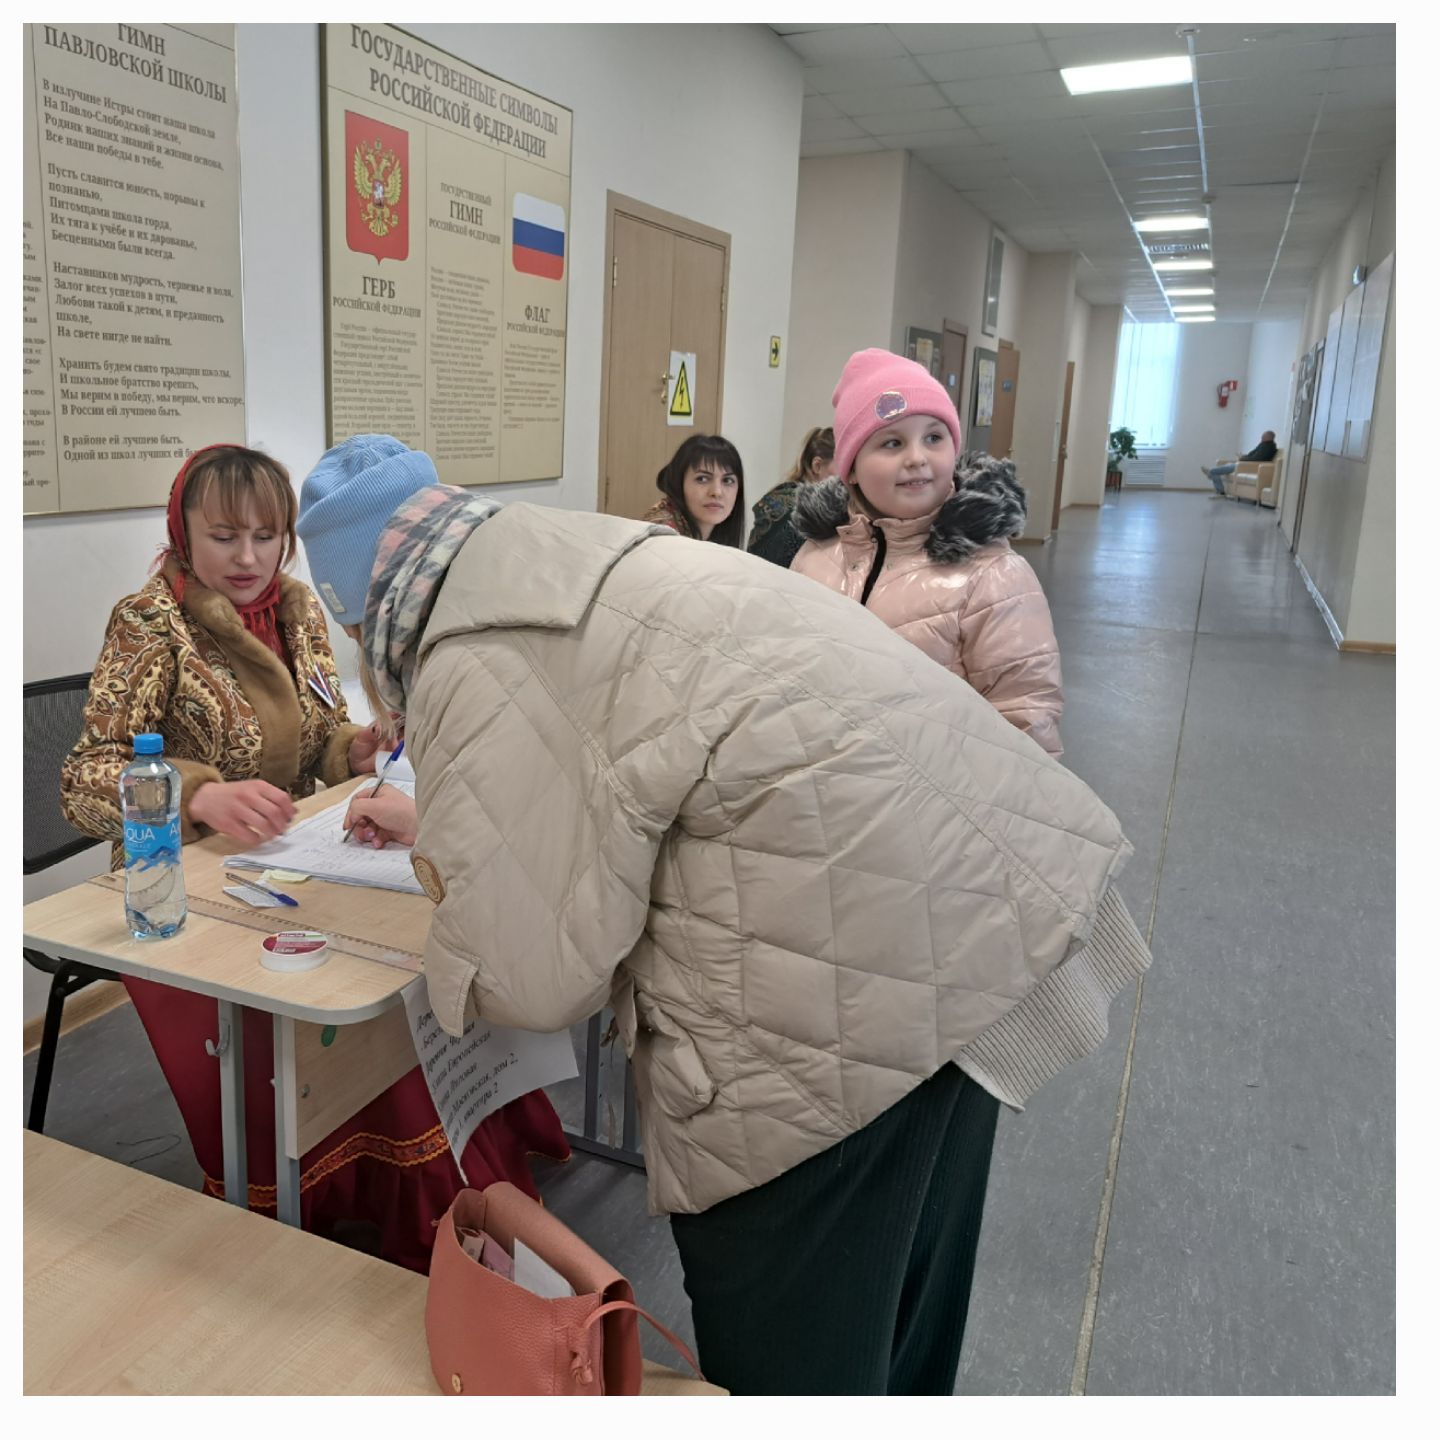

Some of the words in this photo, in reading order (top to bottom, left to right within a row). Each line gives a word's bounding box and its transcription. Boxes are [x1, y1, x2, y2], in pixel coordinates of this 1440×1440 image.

[117, 23, 165, 56] ГИМН
[44, 25, 164, 82] ПАВЛОВСКОЙ
[167, 68, 227, 103] ШКОЛЫ
[43, 78, 50, 90] В
[351, 23, 497, 109] ГОСУДАРСТВЕННЫЕ
[500, 93, 558, 136] СИМВОЛЫ
[44, 96, 58, 110] На
[370, 67, 471, 129] РОССИЙСКОЙ
[473, 112, 546, 159] ФЕДЕРАЦИИ
[45, 112, 83, 133] Родник
[85, 125, 119, 142] наших
[46, 129, 64, 143] Все
[66, 137, 95, 152] наши
[97, 145, 132, 162] победы
[48, 162, 78, 180] Пусть
[80, 172, 124, 190] славится
[50, 196, 110, 217] Питомцами
[112, 211, 143, 224] школа
[450, 200, 483, 226] ГИМН
[51, 213, 65, 226] Их
[67, 218, 90, 229] тяга
[91, 222, 98, 231] к
[100, 224, 127, 236] учёбе
[137, 231, 149, 240] их
[429, 217, 468, 237] РОССИЙСКОЙ
[469, 228, 501, 245] ФЕДЕРАЦИИ
[52, 229, 116, 250] Бесценными
[118, 241, 143, 254] были
[54, 261, 118, 281] Наставников
[54, 277, 84, 291] Залог
[85, 284, 107, 295] всех
[109, 287, 146, 300] успехов
[362, 276, 396, 299] ГЕРБ
[98, 301, 125, 312] такой
[127, 304, 133, 312] к
[333, 296, 381, 313] РОССИЙСКОЙ
[382, 304, 421, 318] ФЕДЕРАЦИИ
[525, 304, 551, 323] ФЛАГ
[57, 325, 71, 337] На
[73, 329, 100, 339] свете
[102, 332, 129, 344] нигде
[131, 334, 142, 344] не
[59, 357, 101, 371] Хранить
[103, 360, 132, 374] будем
[133, 364, 158, 373] свято
[60, 373, 68, 384] И
[70, 376, 119, 386] школьное
[121, 376, 161, 389] братство
[60, 389, 78, 400] Мы
[81, 392, 111, 403] верим
[113, 392, 119, 400] в
[156, 394, 170, 403] мы
[62, 404, 68, 415] В
[70, 404, 104, 415] России
[106, 405, 117, 415] ей
[64, 435, 70, 446] В
[72, 435, 107, 448] районе
[109, 435, 120, 445] ей
[64, 449, 95, 463] Одной
[97, 451, 109, 460] из
[111, 451, 135, 460] школ
